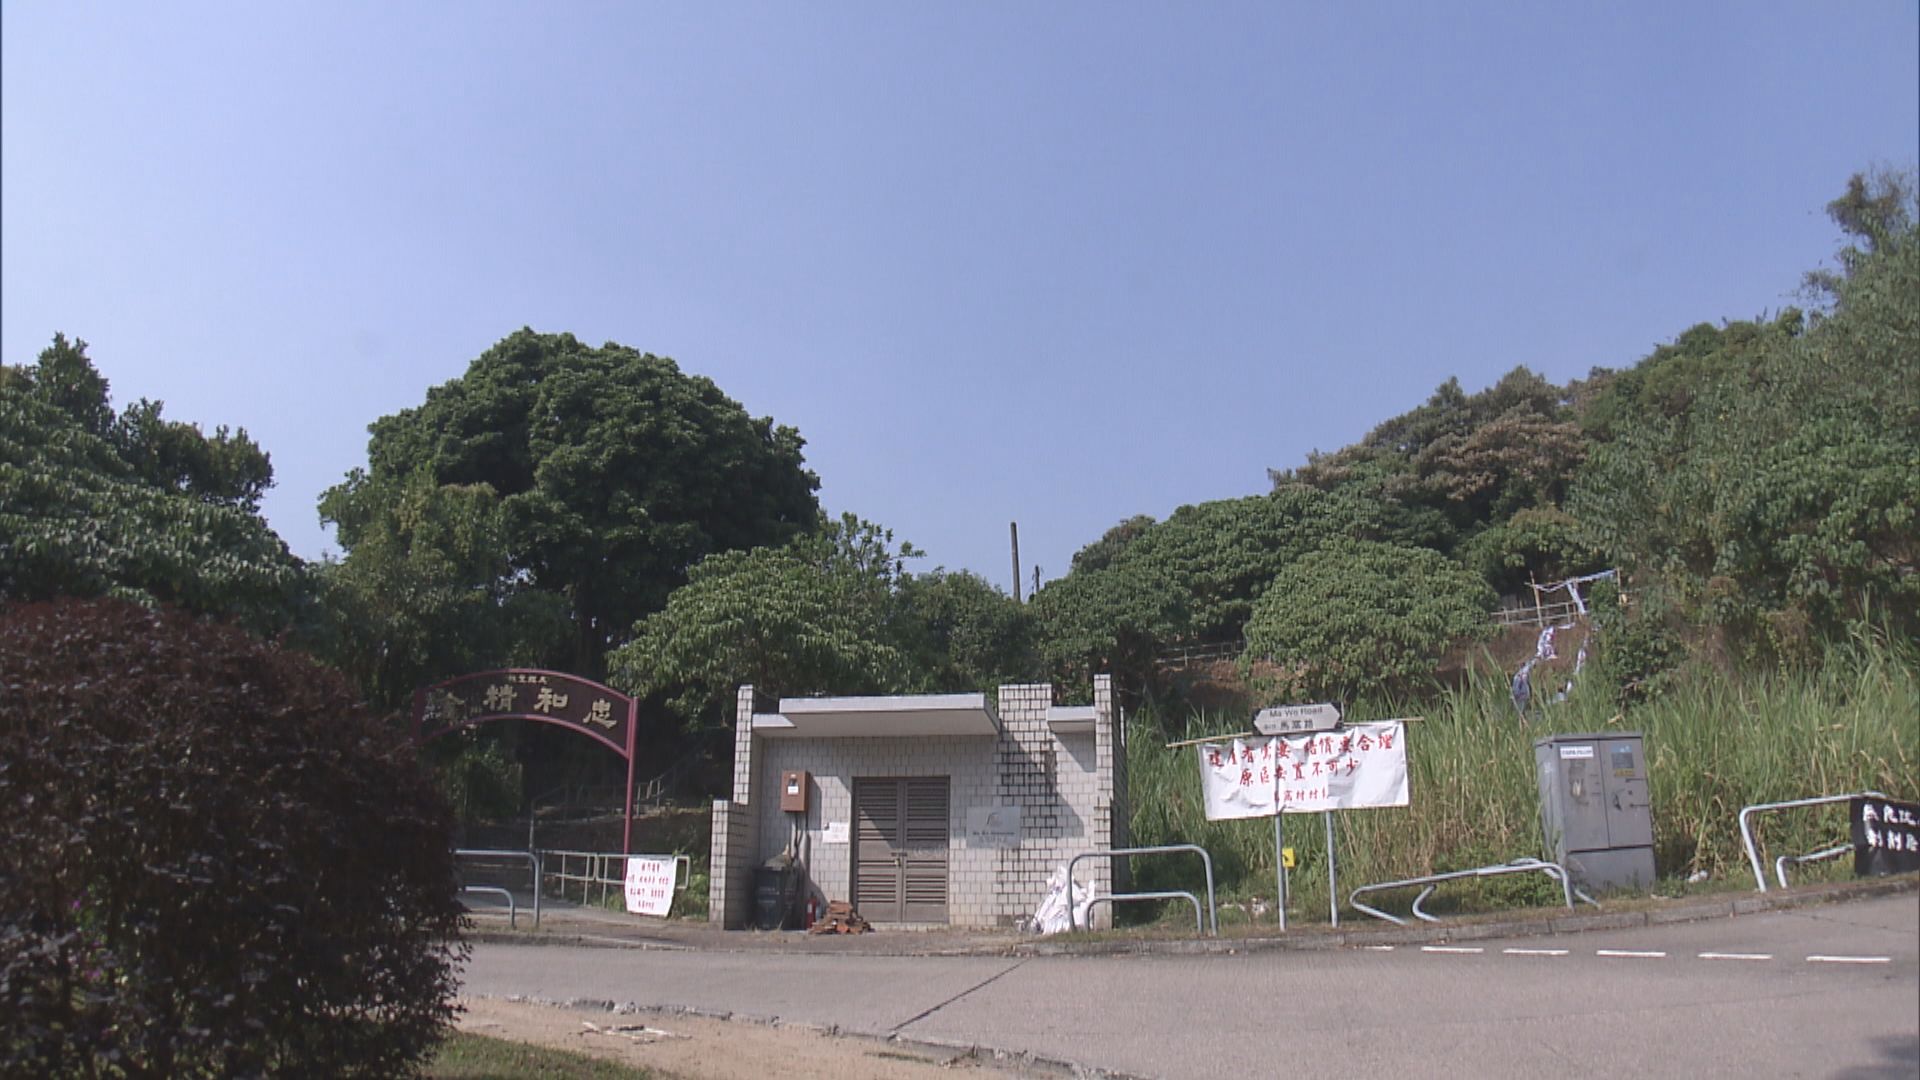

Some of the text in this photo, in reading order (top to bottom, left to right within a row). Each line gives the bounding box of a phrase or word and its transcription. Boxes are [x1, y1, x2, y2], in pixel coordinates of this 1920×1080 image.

[1270, 705, 1324, 717] Ma Wo Road
